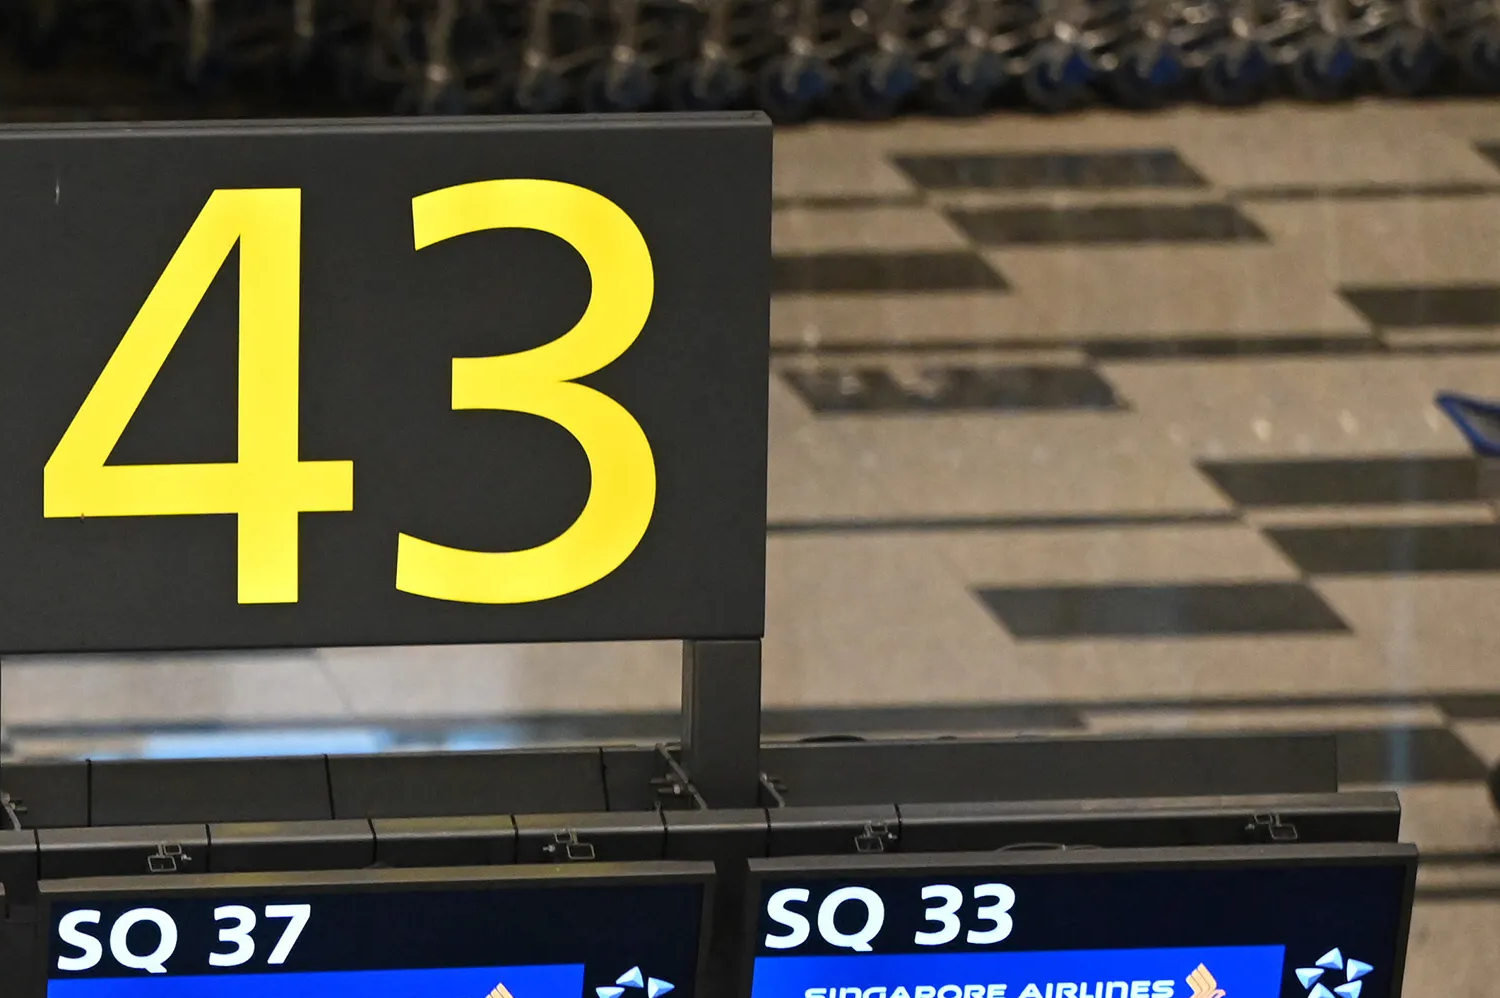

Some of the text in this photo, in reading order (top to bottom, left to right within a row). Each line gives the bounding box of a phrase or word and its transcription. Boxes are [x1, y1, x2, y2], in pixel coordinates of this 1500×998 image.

[43, 178, 657, 605] 43
[57, 903, 311, 974] SQ 37
[764, 883, 1016, 952] SQ 33
